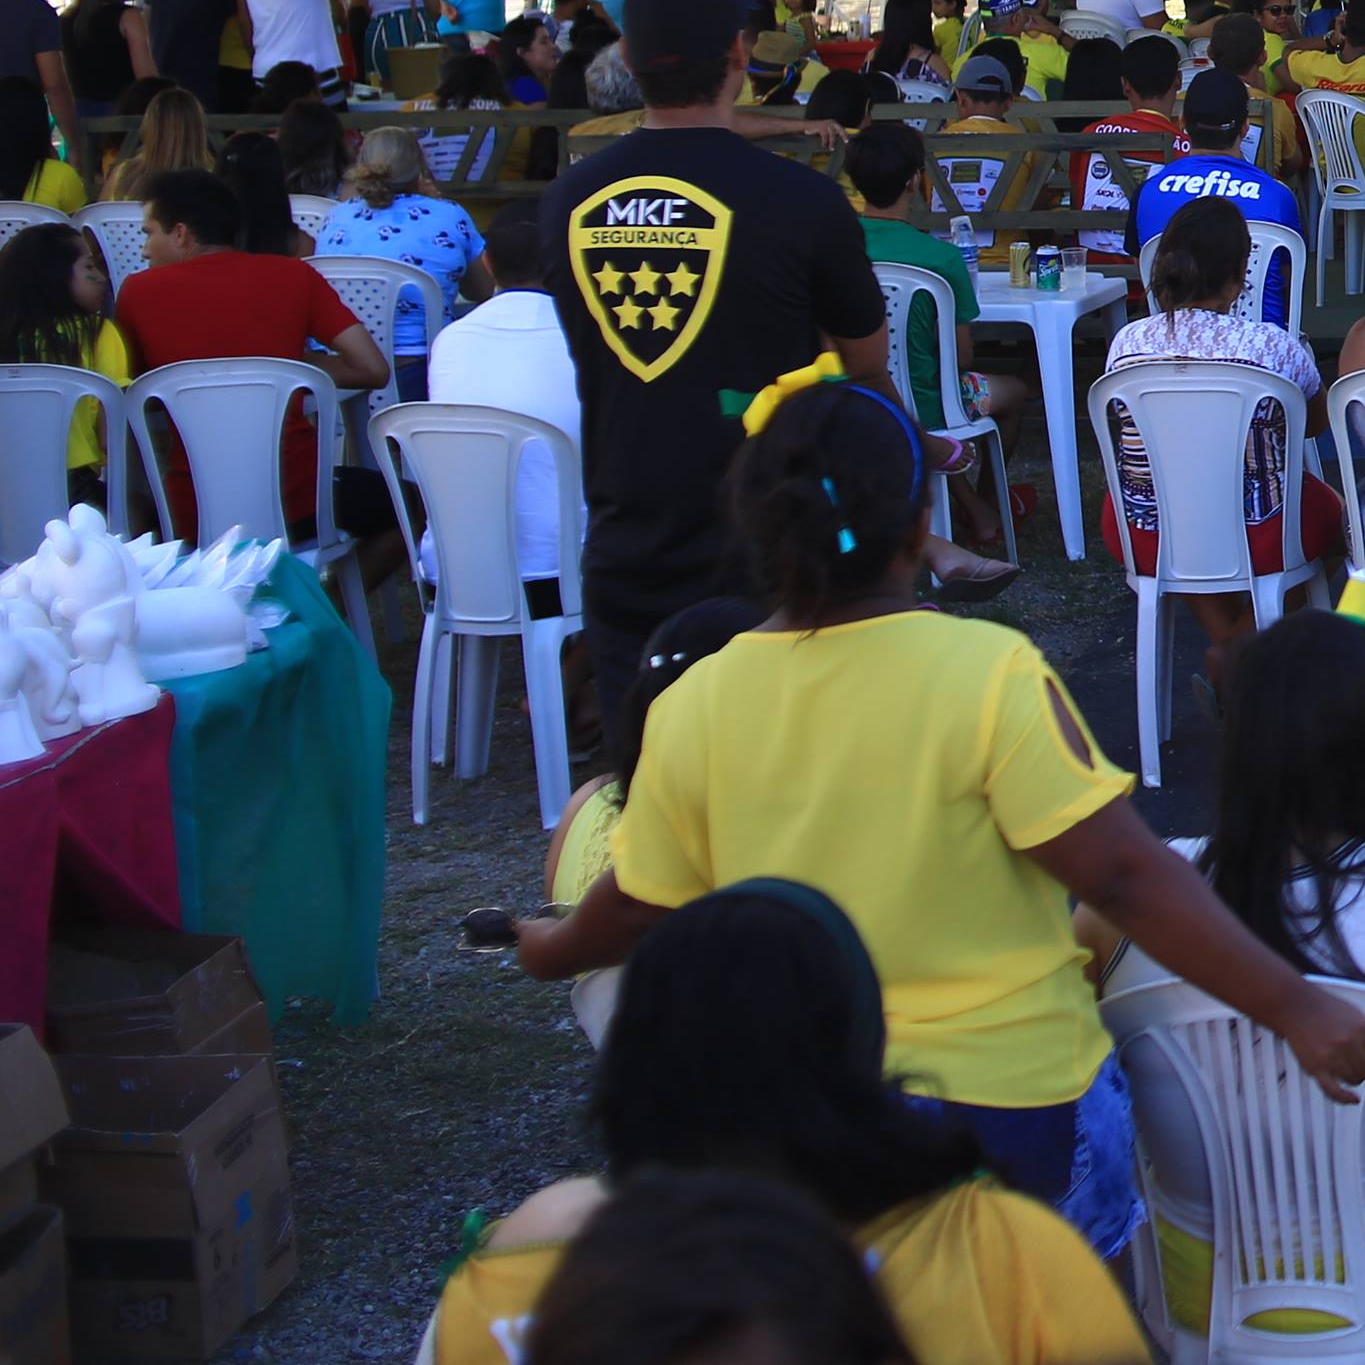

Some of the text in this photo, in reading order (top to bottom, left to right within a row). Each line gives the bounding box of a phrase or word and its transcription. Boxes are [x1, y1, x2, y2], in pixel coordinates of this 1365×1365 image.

[1158, 170, 1261, 200] crefisa
[606, 199, 689, 225] MKF
[590, 229, 698, 248] SEGURANÇA
